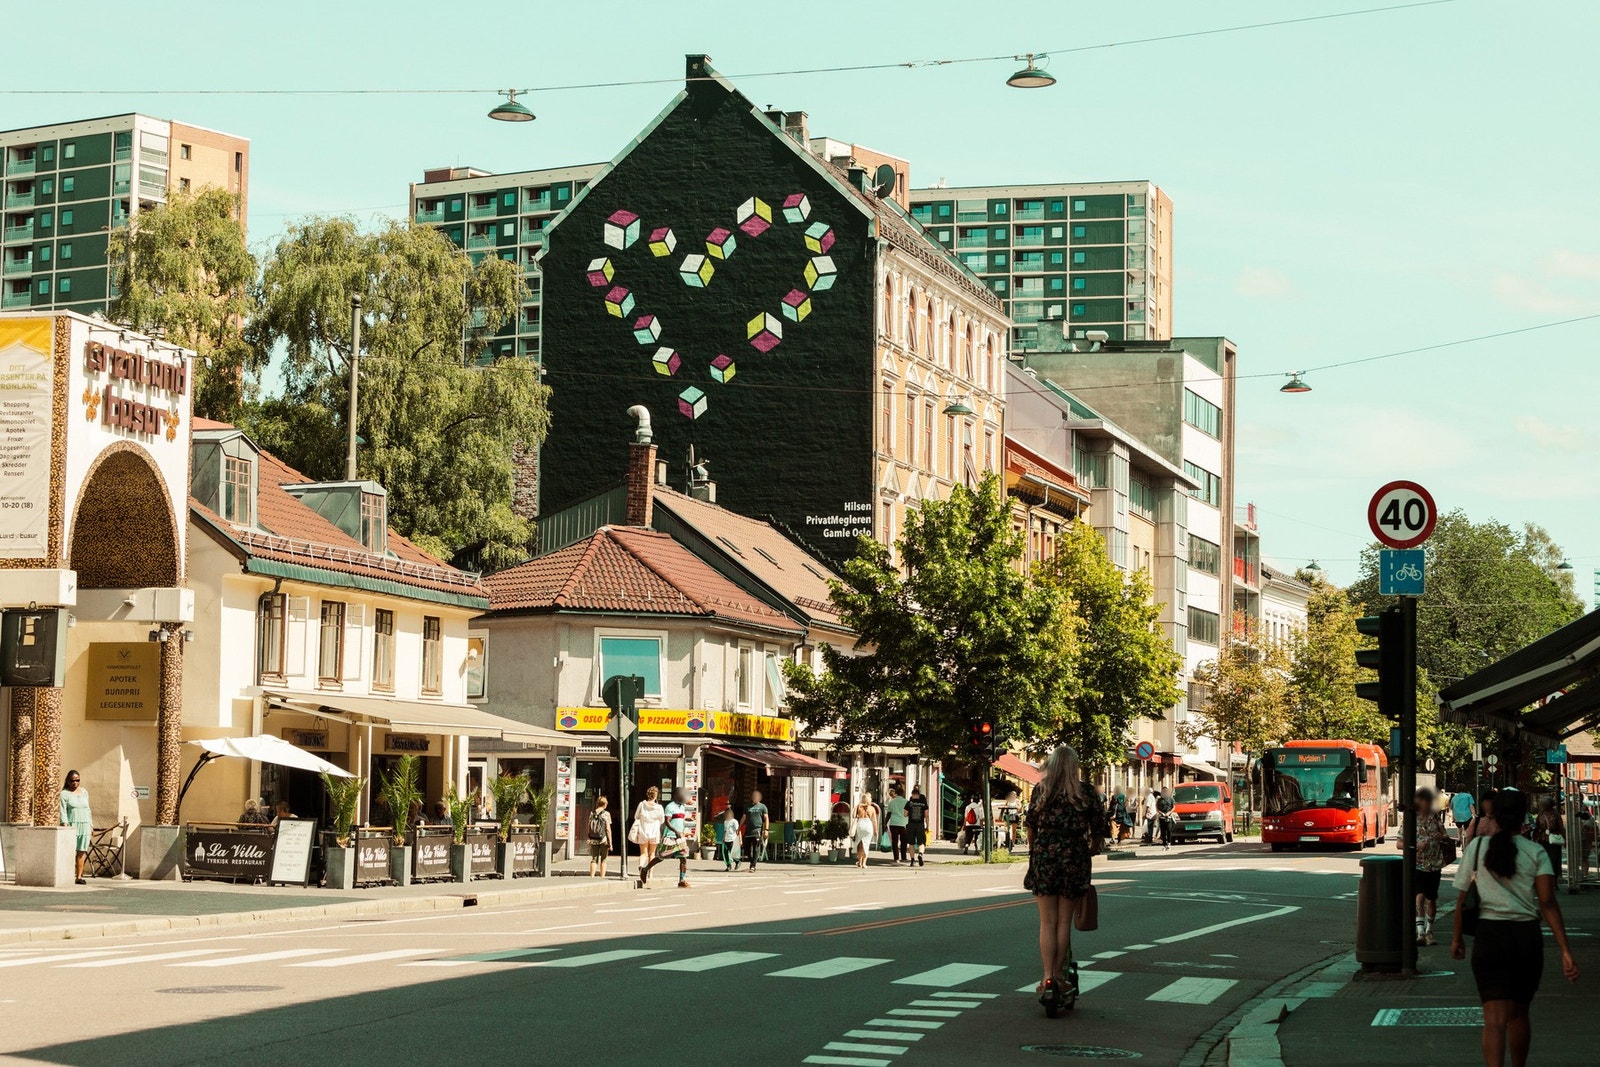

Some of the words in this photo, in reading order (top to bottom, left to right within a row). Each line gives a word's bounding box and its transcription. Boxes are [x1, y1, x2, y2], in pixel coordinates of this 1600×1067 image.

[844, 502, 871, 511] Hilsen
[1380, 498, 1426, 531] 40
[806, 515, 871, 526] PrivatMegleren
[823, 528, 850, 537] Gamle
[852, 527, 872, 538] Oslo
[109, 675, 137, 683] APOTEK
[100, 701, 144, 709] LEGESENTER
[583, 715, 602, 724] OSLO
[647, 716, 687, 726] PIZZAHUS
[1278, 754, 1286, 764] 37
[1298, 754, 1320, 763] Nydalen
[1321, 754, 1326, 762] T
[206, 842, 230, 857] La
[231, 844, 266, 859] Villa
